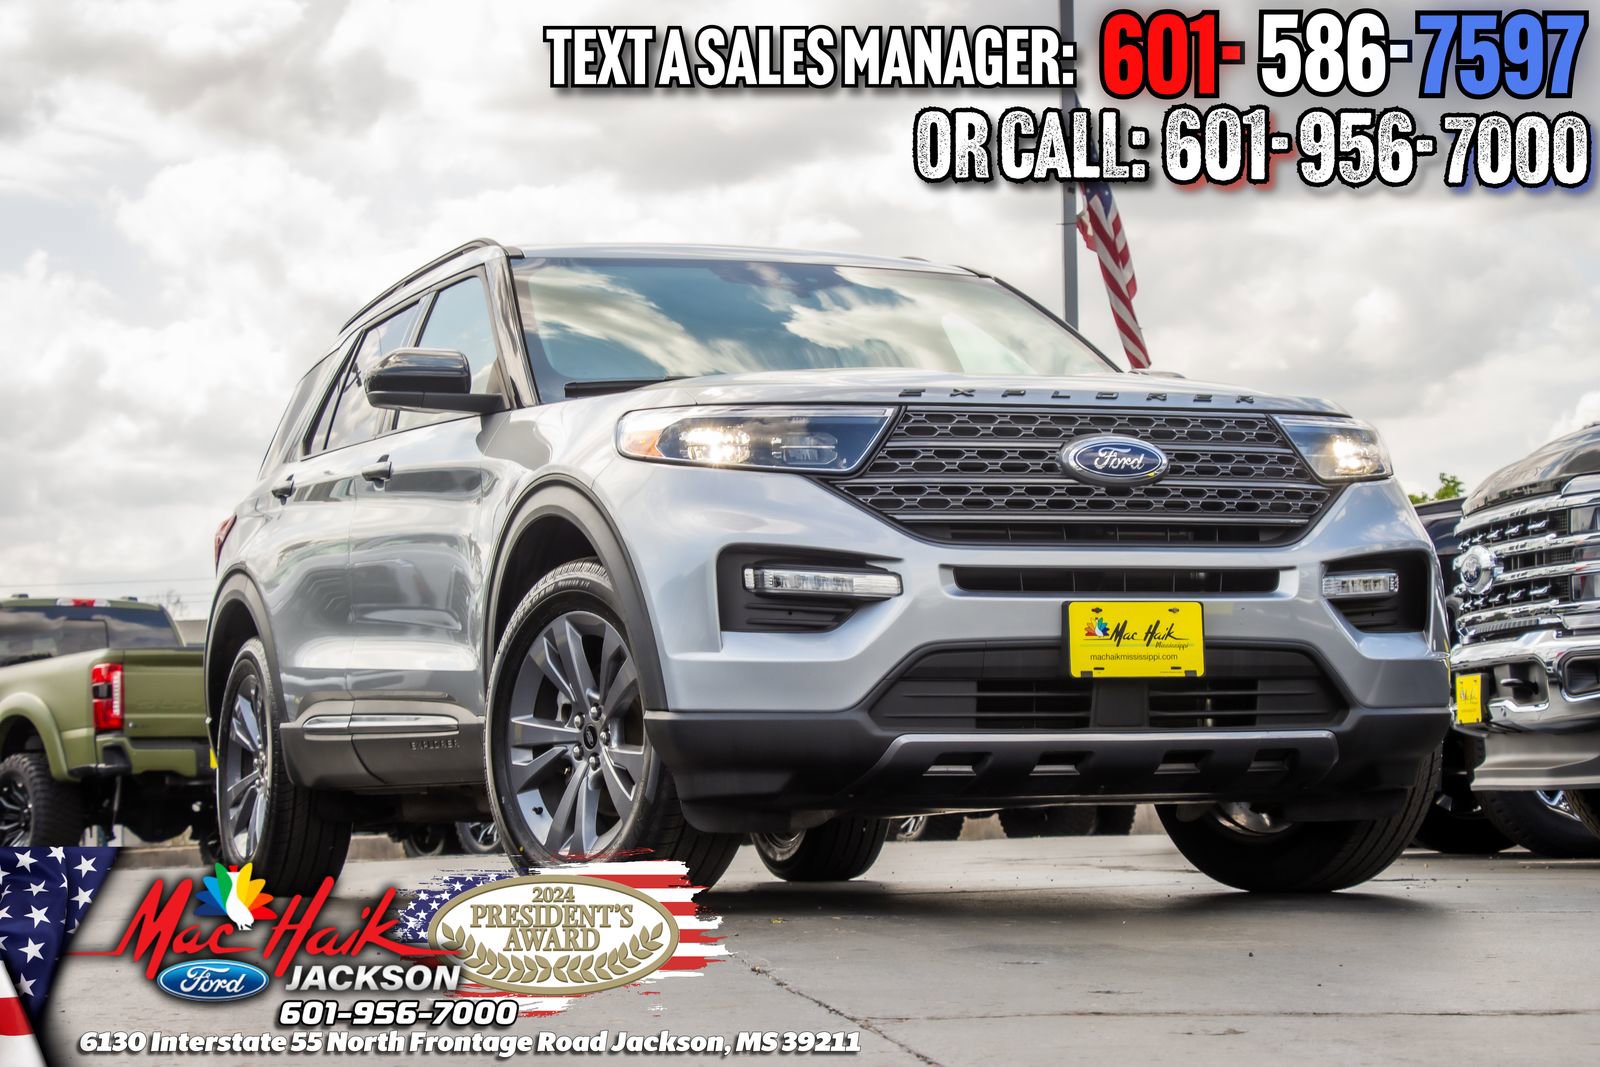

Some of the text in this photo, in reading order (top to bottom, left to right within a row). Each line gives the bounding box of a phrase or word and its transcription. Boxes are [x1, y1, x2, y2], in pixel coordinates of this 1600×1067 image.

[898, 387, 1255, 405] EXPLORER
[1093, 447, 1145, 471] Ford
[1108, 620, 1178, 647] Mac Haik
[1090, 653, 1178, 661] machaikmississippi.com
